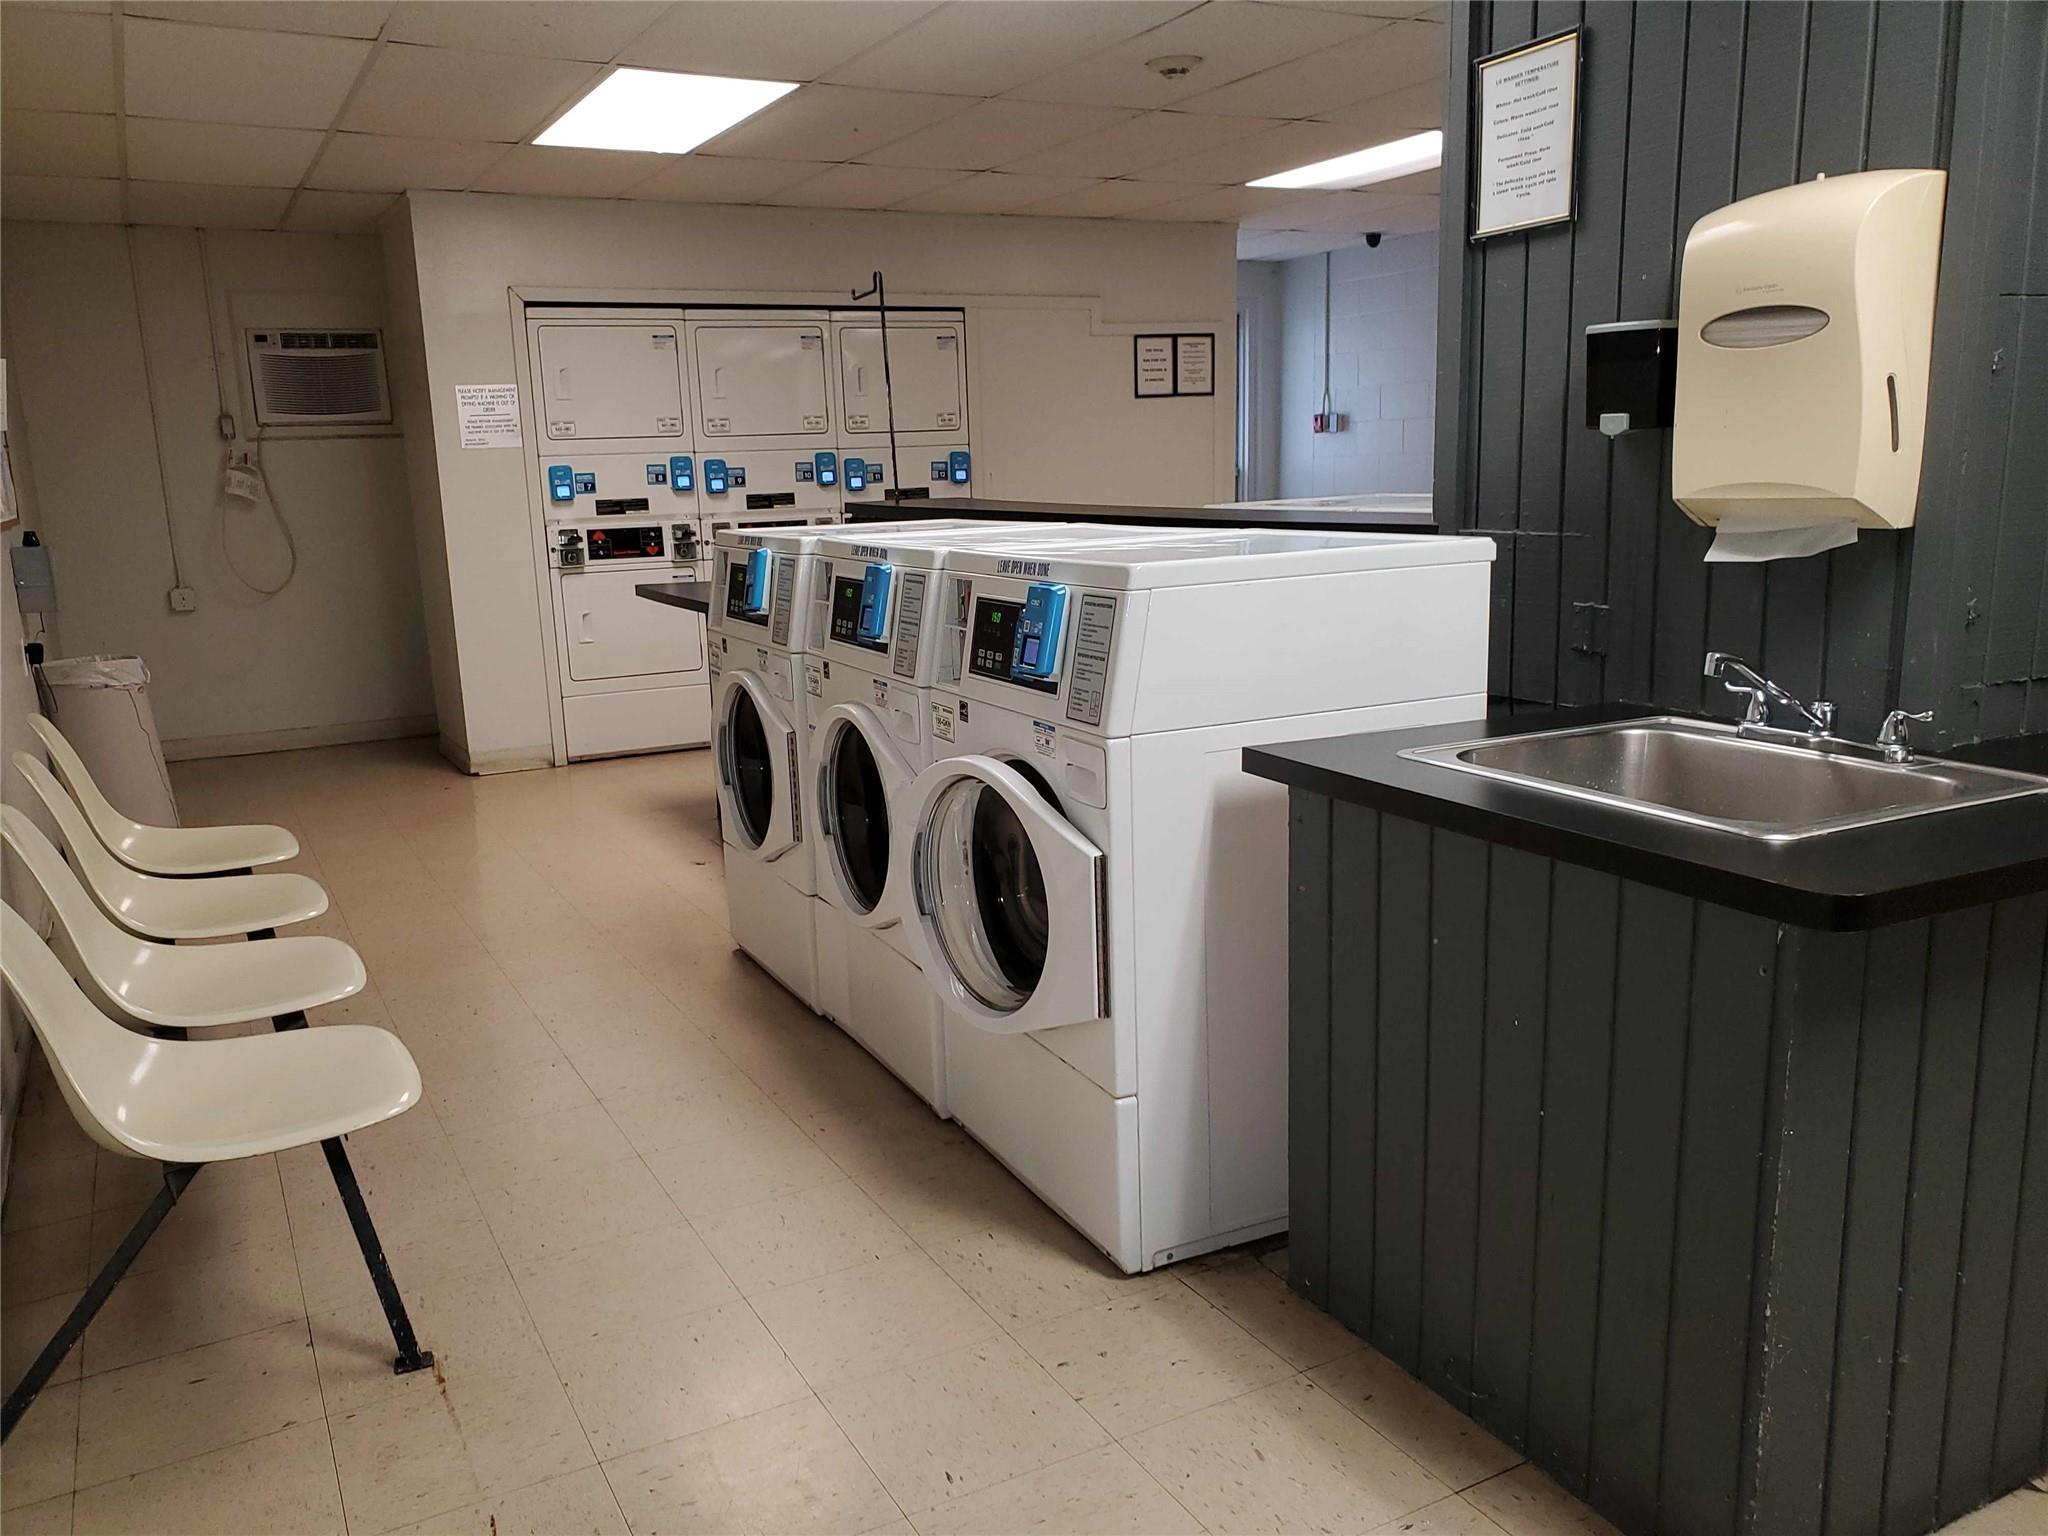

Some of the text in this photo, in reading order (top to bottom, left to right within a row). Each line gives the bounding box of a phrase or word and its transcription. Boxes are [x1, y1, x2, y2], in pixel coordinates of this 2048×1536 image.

[1525, 61, 1559, 76] TEMPERATURE
[998, 560, 1050, 577] LEAVE OPEN WHEN DONE
